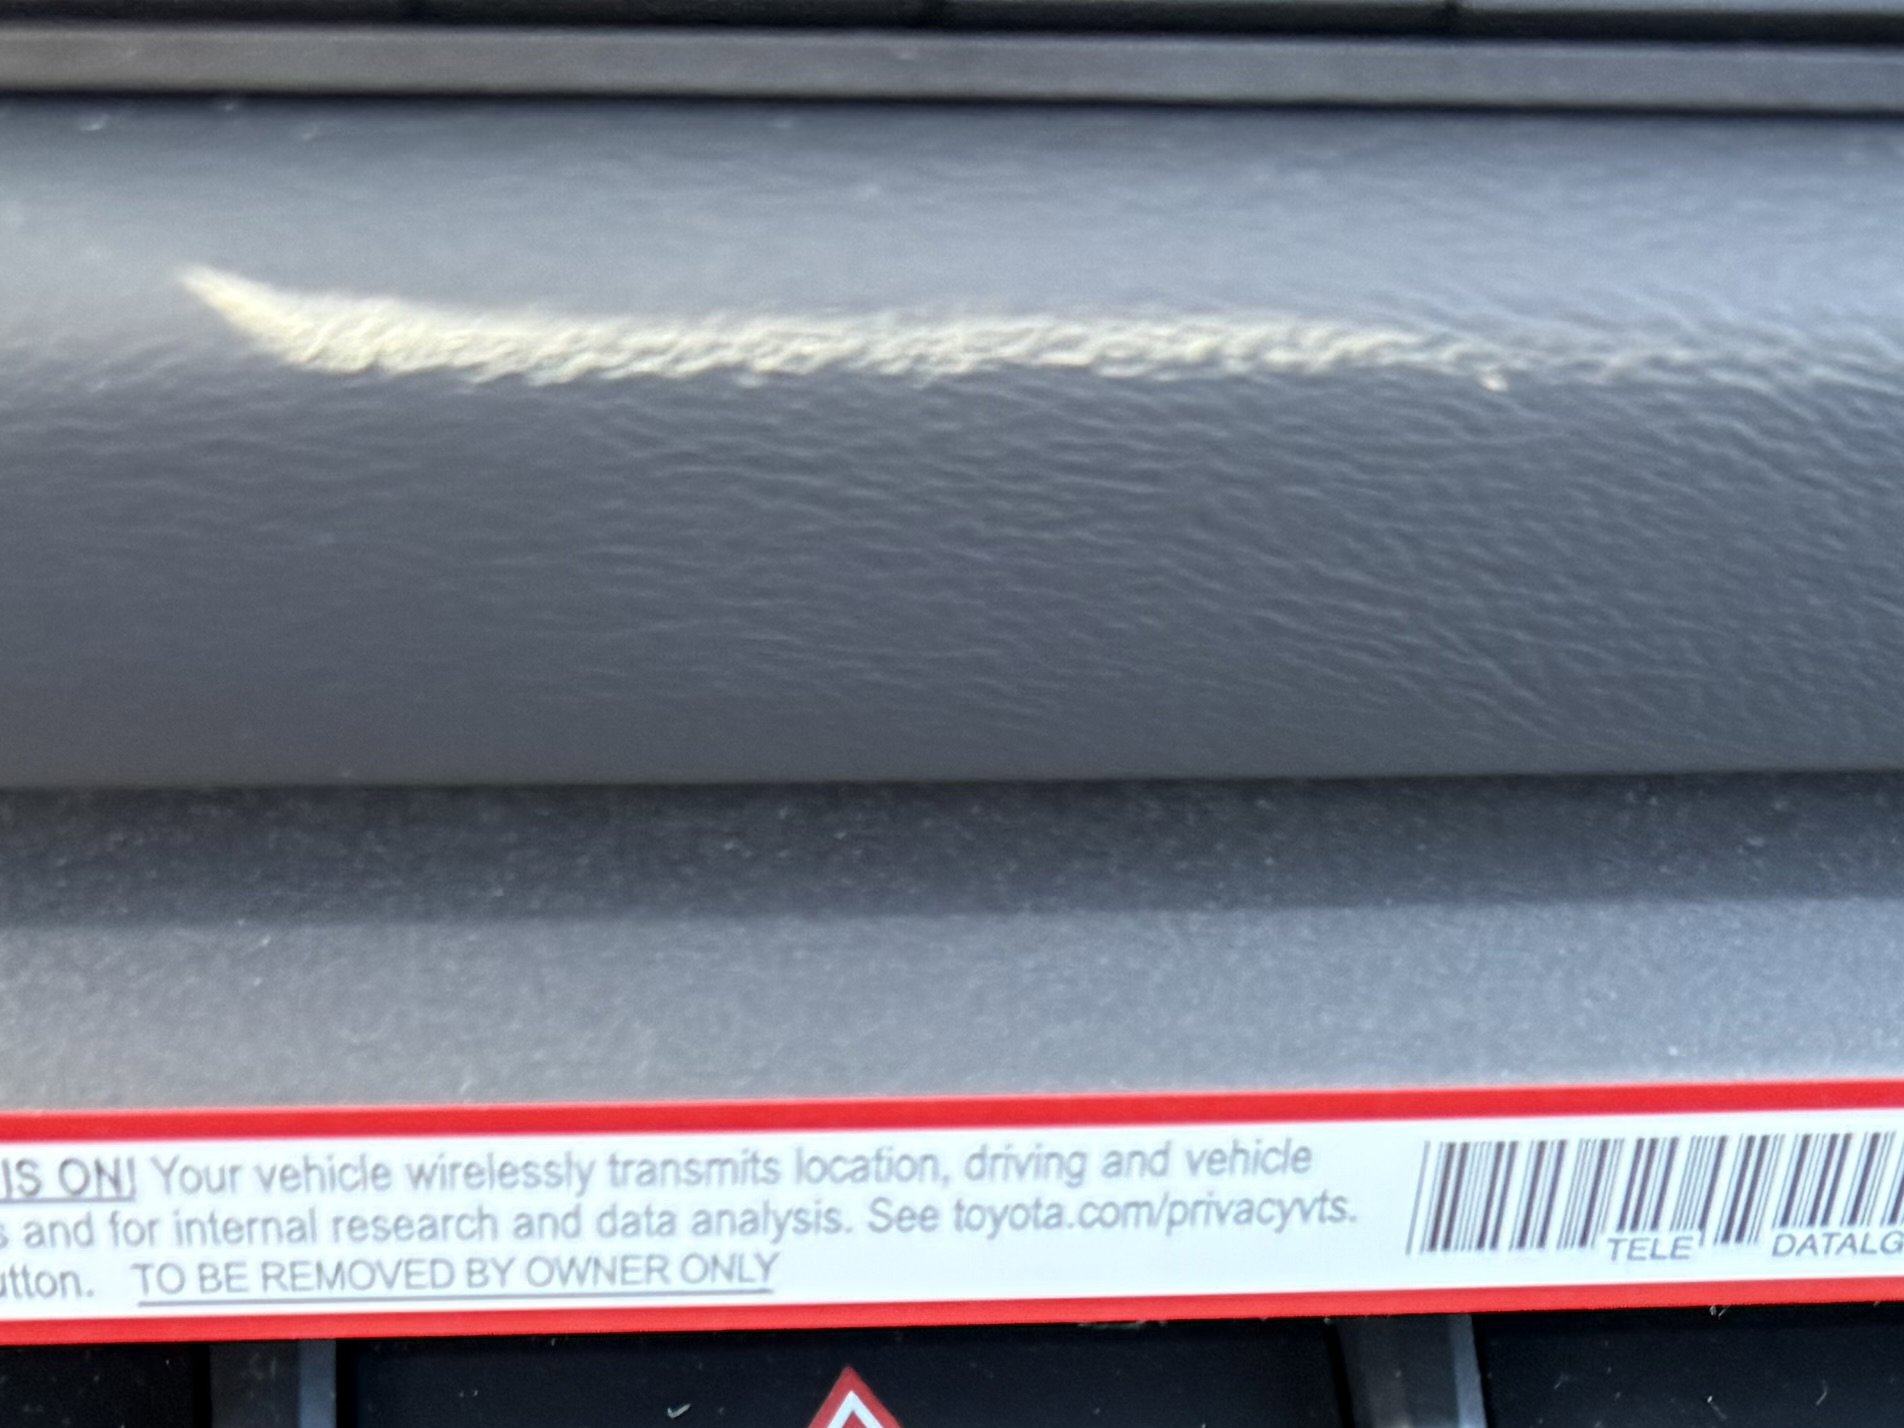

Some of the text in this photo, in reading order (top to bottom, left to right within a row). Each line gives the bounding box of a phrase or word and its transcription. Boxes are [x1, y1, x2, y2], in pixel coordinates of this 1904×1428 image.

[3, 1157, 43, 1199] IS
[58, 1156, 136, 1198] ON!
[151, 1152, 242, 1197] Your
[255, 1151, 393, 1195] vehicle
[406, 1148, 595, 1198] wirelessly
[608, 1146, 781, 1189] transmits
[794, 1145, 950, 1190] location,
[964, 1141, 1087, 1188] driving
[1101, 1140, 1171, 1178] and
[1185, 1137, 1312, 1177] vehicle
[23, 1211, 95, 1250] and
[107, 1209, 159, 1248] for
[173, 1206, 318, 1246] internal
[332, 1203, 496, 1242] research
[513, 1202, 583, 1240] and
[596, 1200, 678, 1237] data
[690, 1198, 853, 1244] analysis.
[866, 1197, 939, 1234] See
[952, 1189, 1358, 1240] toyota.com/privacyvts.
[131, 1261, 186, 1296] TO
[198, 1260, 249, 1294] BE
[262, 1256, 455, 1293] REMOVED
[467, 1254, 515, 1289] BY
[525, 1252, 670, 1287] OWNER
[680, 1250, 781, 1285] ONLY
[1608, 1231, 1695, 1263] TELE
